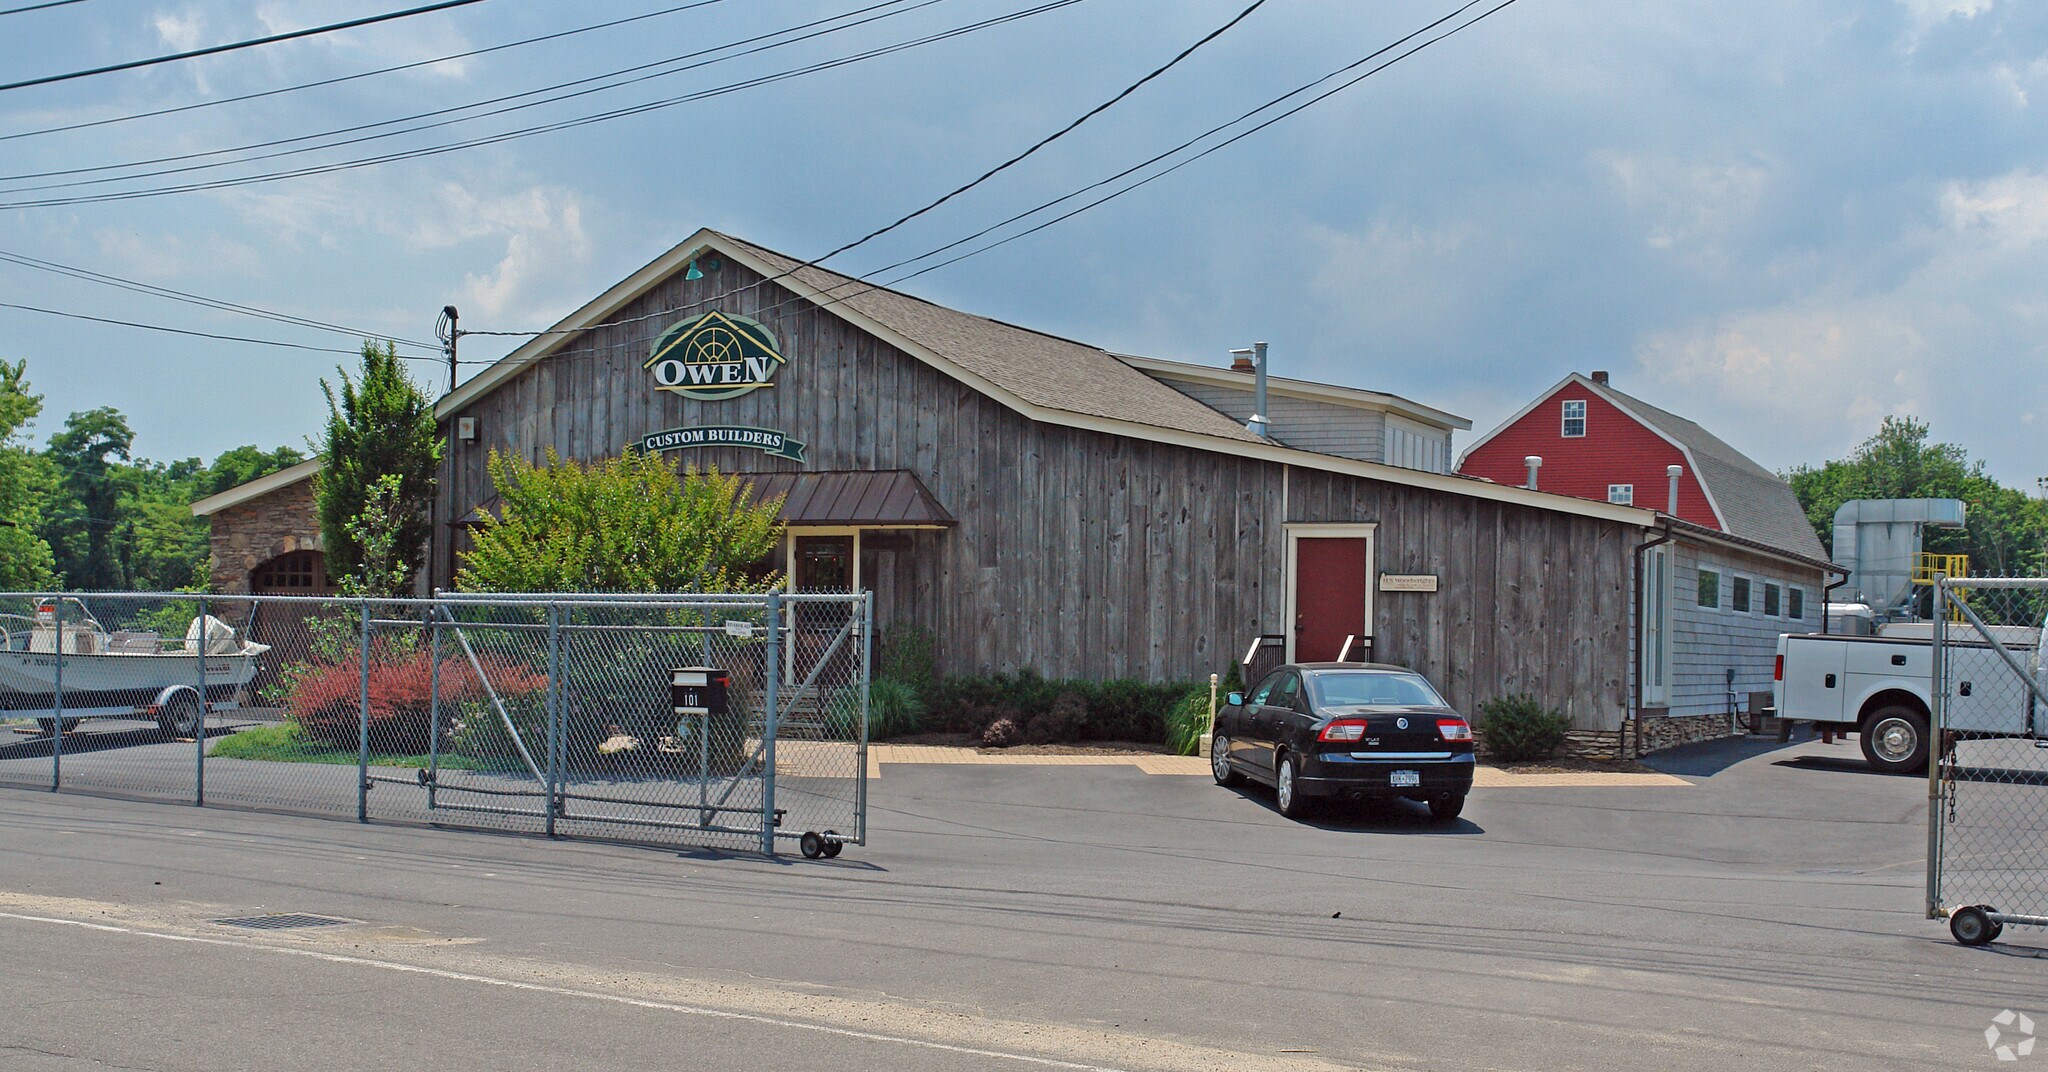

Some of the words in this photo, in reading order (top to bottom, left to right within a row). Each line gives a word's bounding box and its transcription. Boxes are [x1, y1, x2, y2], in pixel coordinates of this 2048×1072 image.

[655, 356, 769, 386] OWEN
[646, 430, 704, 449] CUSTOM
[708, 429, 781, 447] BUILDERS
[684, 694, 698, 706] 101
